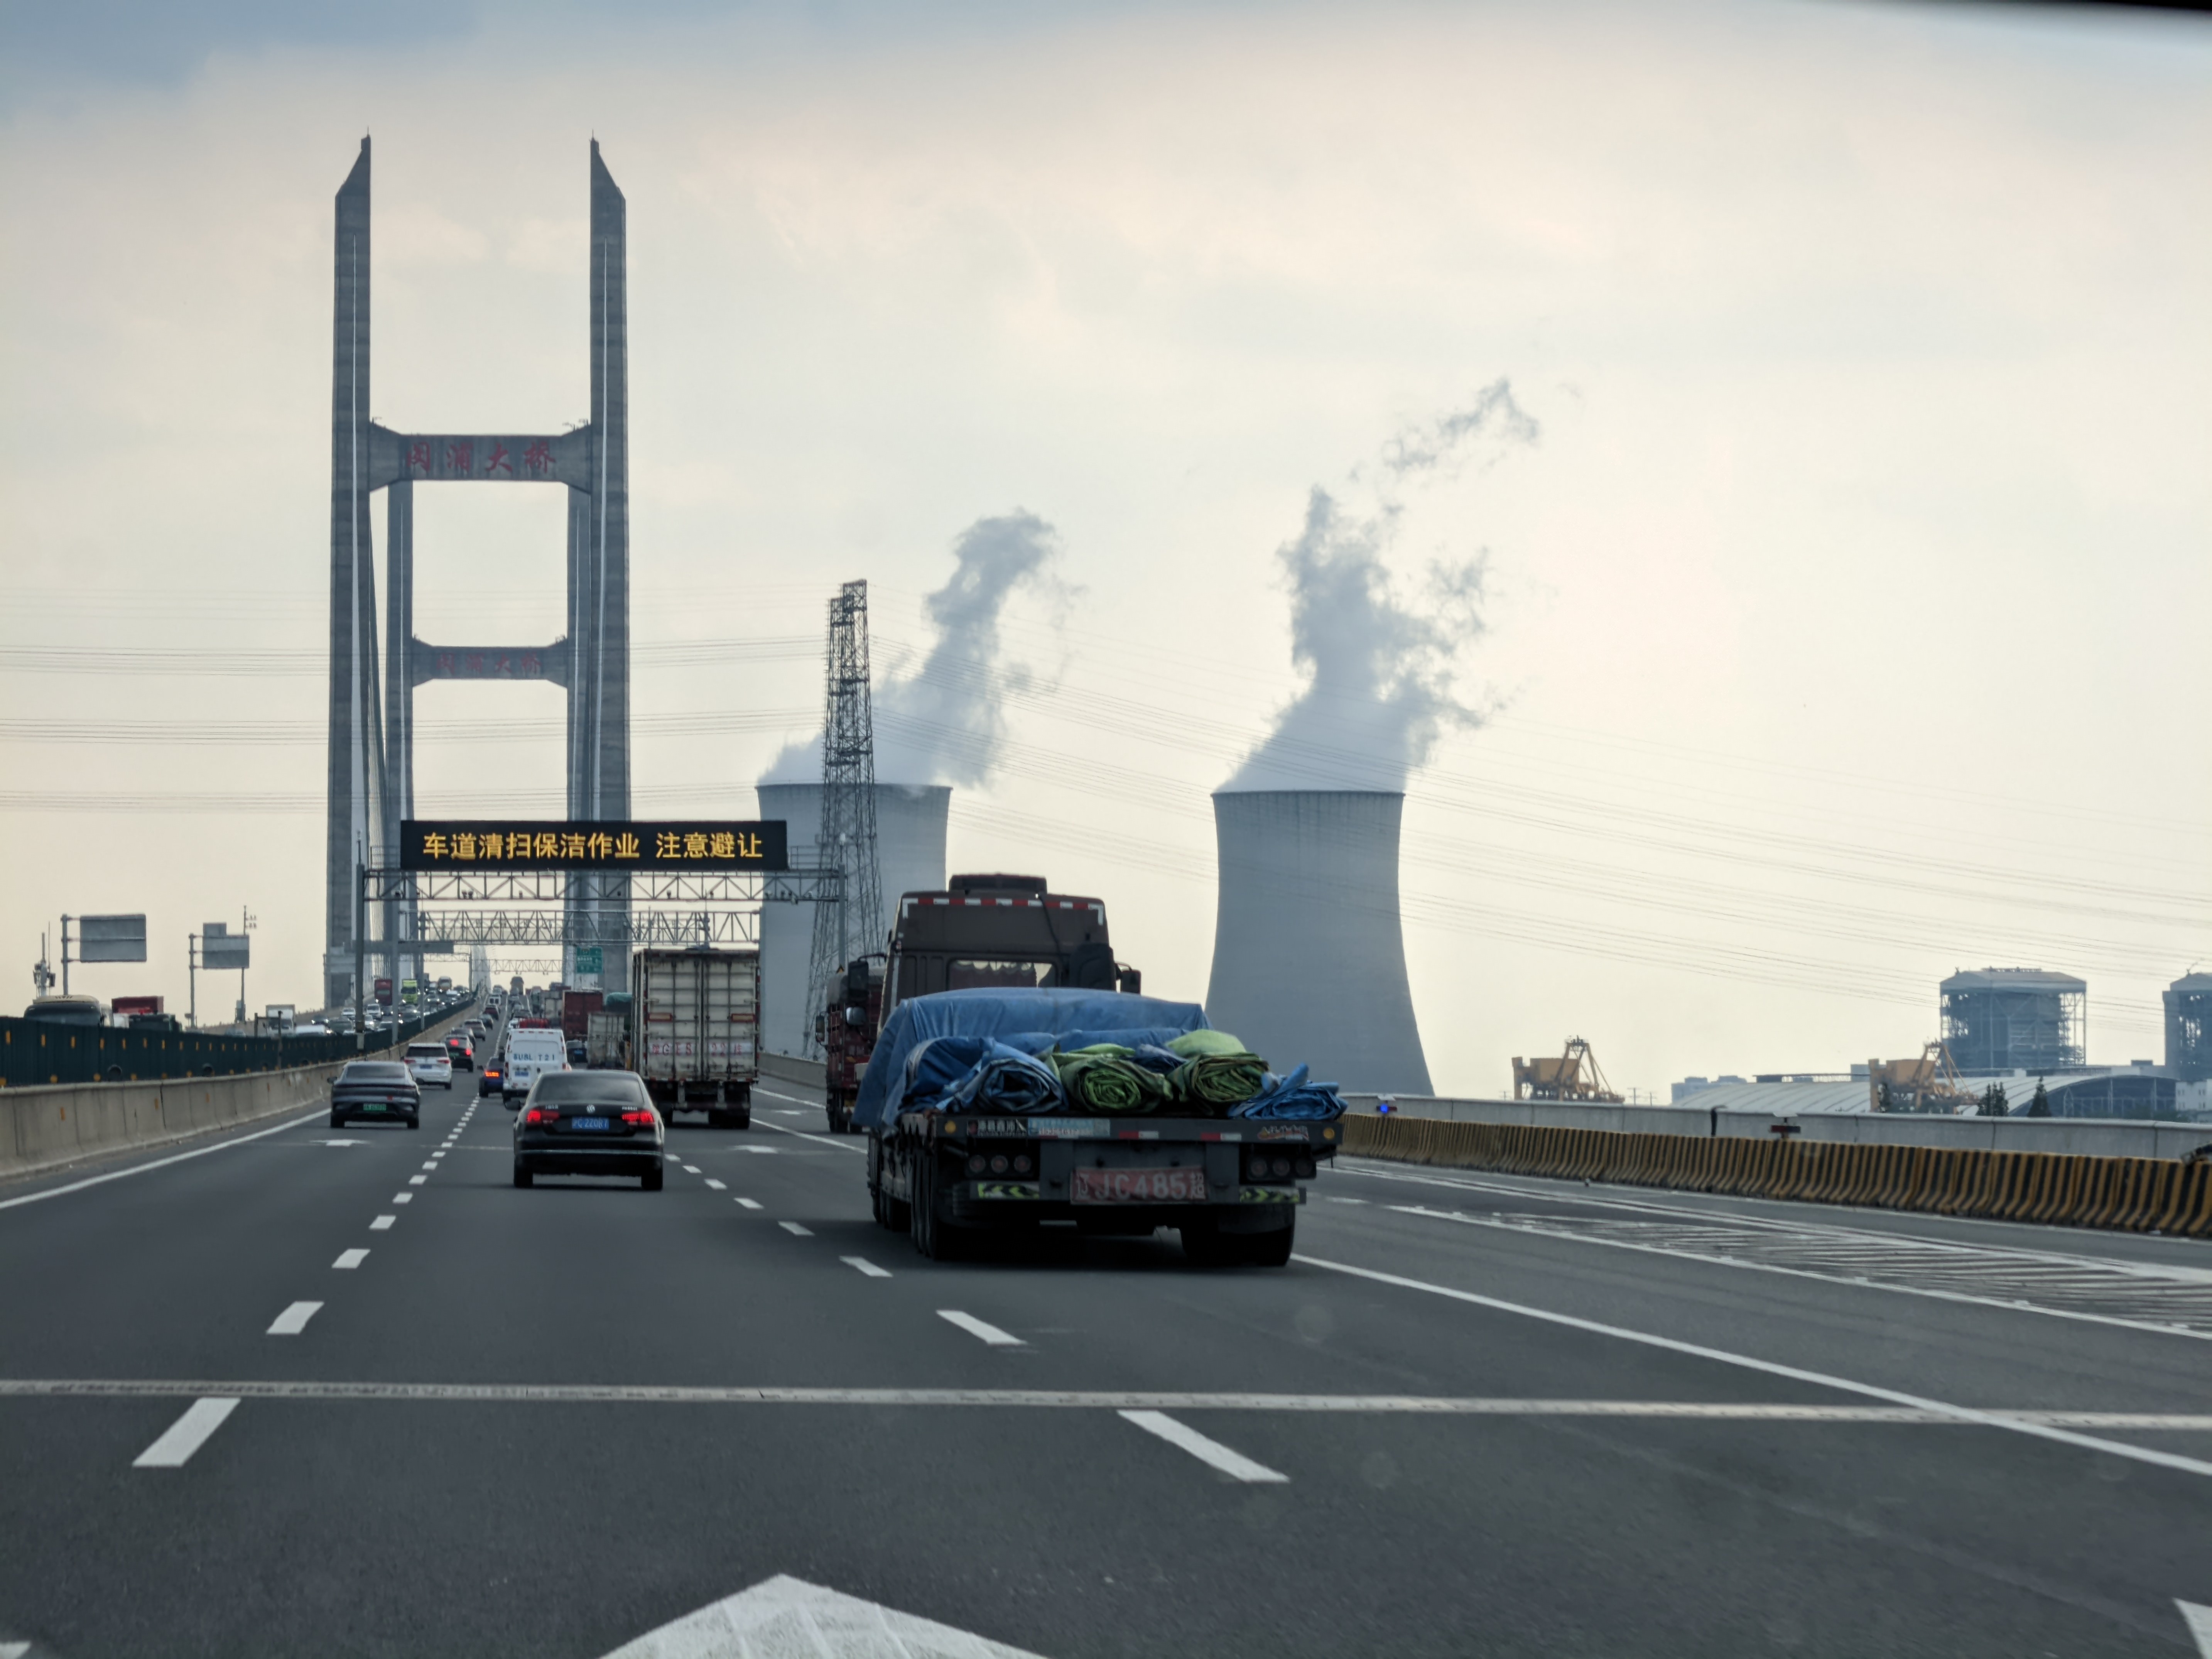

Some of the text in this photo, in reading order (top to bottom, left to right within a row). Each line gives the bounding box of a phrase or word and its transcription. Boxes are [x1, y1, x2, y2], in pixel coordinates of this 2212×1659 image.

[406, 441, 556, 473] 闵浦大桥
[423, 832, 763, 860] 车道清扫保洁作业 注意避让
